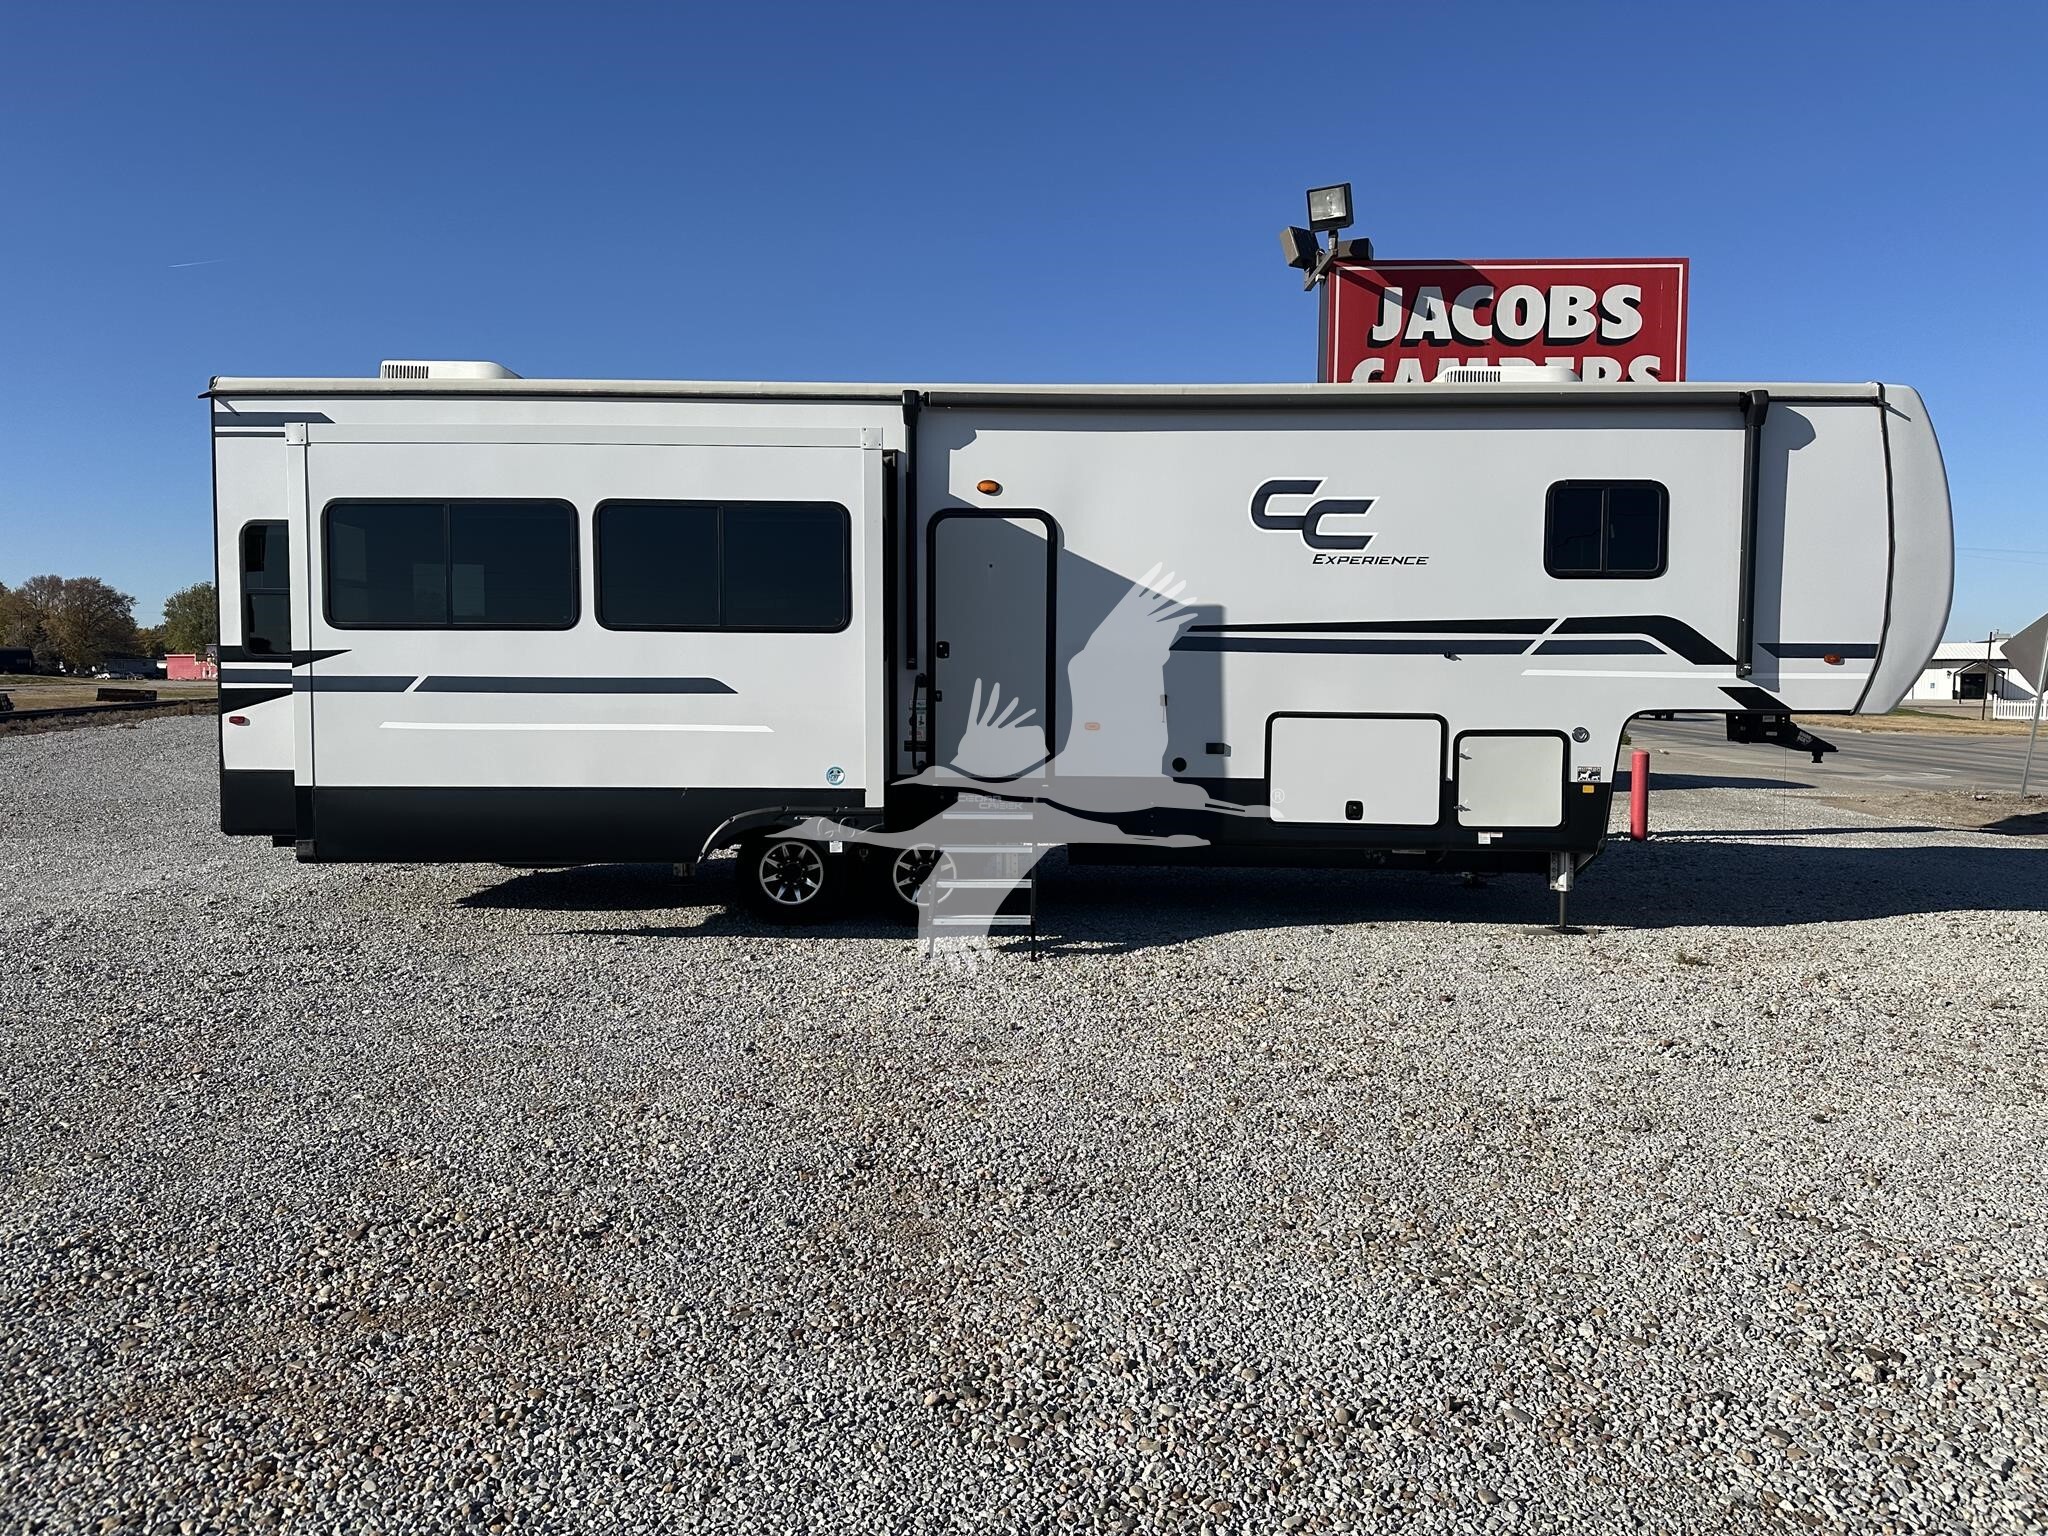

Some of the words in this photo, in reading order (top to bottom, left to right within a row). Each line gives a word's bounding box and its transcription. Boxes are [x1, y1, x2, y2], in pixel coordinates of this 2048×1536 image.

[1369, 284, 1643, 345] JACOBS
[1351, 355, 1661, 383] CARS
[1312, 553, 1430, 565] EXPERIENCE
